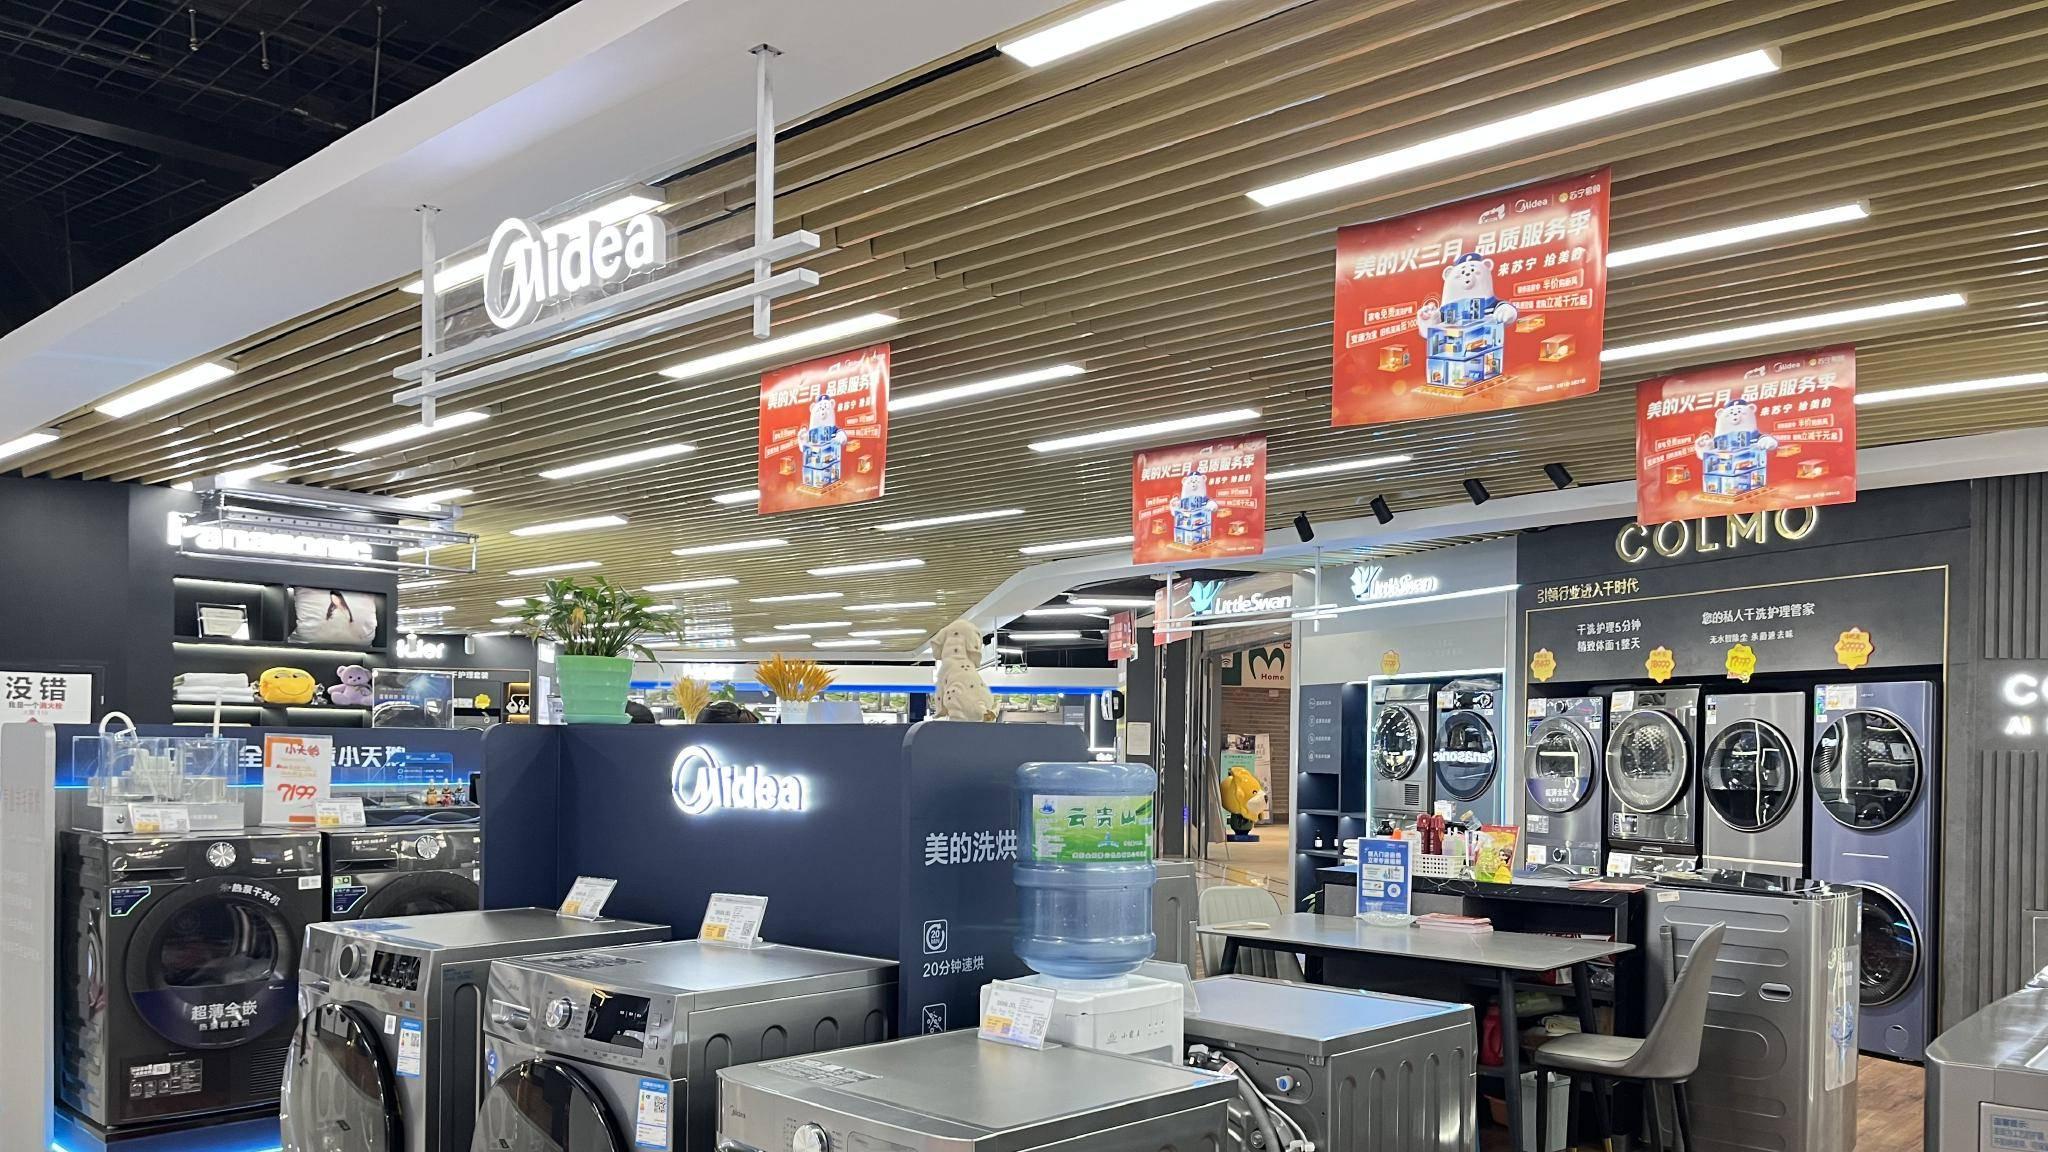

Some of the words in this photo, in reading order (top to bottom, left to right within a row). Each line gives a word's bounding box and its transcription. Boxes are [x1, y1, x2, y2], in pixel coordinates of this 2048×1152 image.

[1515, 199, 1548, 213] Midea
[1352, 238, 1464, 280] 美的火三月
[1473, 208, 1592, 256] 品质服务季
[484, 216, 666, 330] Midea
[1497, 258, 1537, 278] 来苏宁
[1544, 246, 1586, 268] 抢美的
[1773, 361, 1801, 372] Midea
[767, 384, 821, 410] 美的火三月
[1646, 389, 1732, 420] 美的火三月
[1741, 372, 1837, 402] 品质服务季
[1759, 403, 1792, 417] 来苏宁
[1798, 397, 1832, 412] 抢美的
[1141, 462, 1192, 482] 美的火三月
[1197, 454, 1255, 474] 品质服务季
[167, 511, 373, 561] Panasonic
[1615, 506, 1817, 563] COLMO
[1370, 574, 1439, 599] LittleSwan
[1537, 578, 1640, 604] 引领行业进入干时代
[1215, 592, 1292, 614] LittleSwan
[1702, 602, 1816, 625] 您的私人干洗护理管家
[1577, 618, 1642, 636] 干洗护理5分钟
[1577, 637, 1641, 653] 精致体面1整天
[6, 676, 67, 701] 没错
[2004, 673, 2048, 705] C
[277, 783, 318, 802] 7199
[672, 744, 807, 816] Midea
[1066, 802, 1136, 828] 云贵山
[924, 829, 1017, 867] 美的洗烘
[231, 883, 281, 906] 热泵干衣机
[931, 930, 940, 938] 20
[923, 956, 984, 978] 20分钟速烘
[191, 1000, 257, 1020] 超薄全嵌
